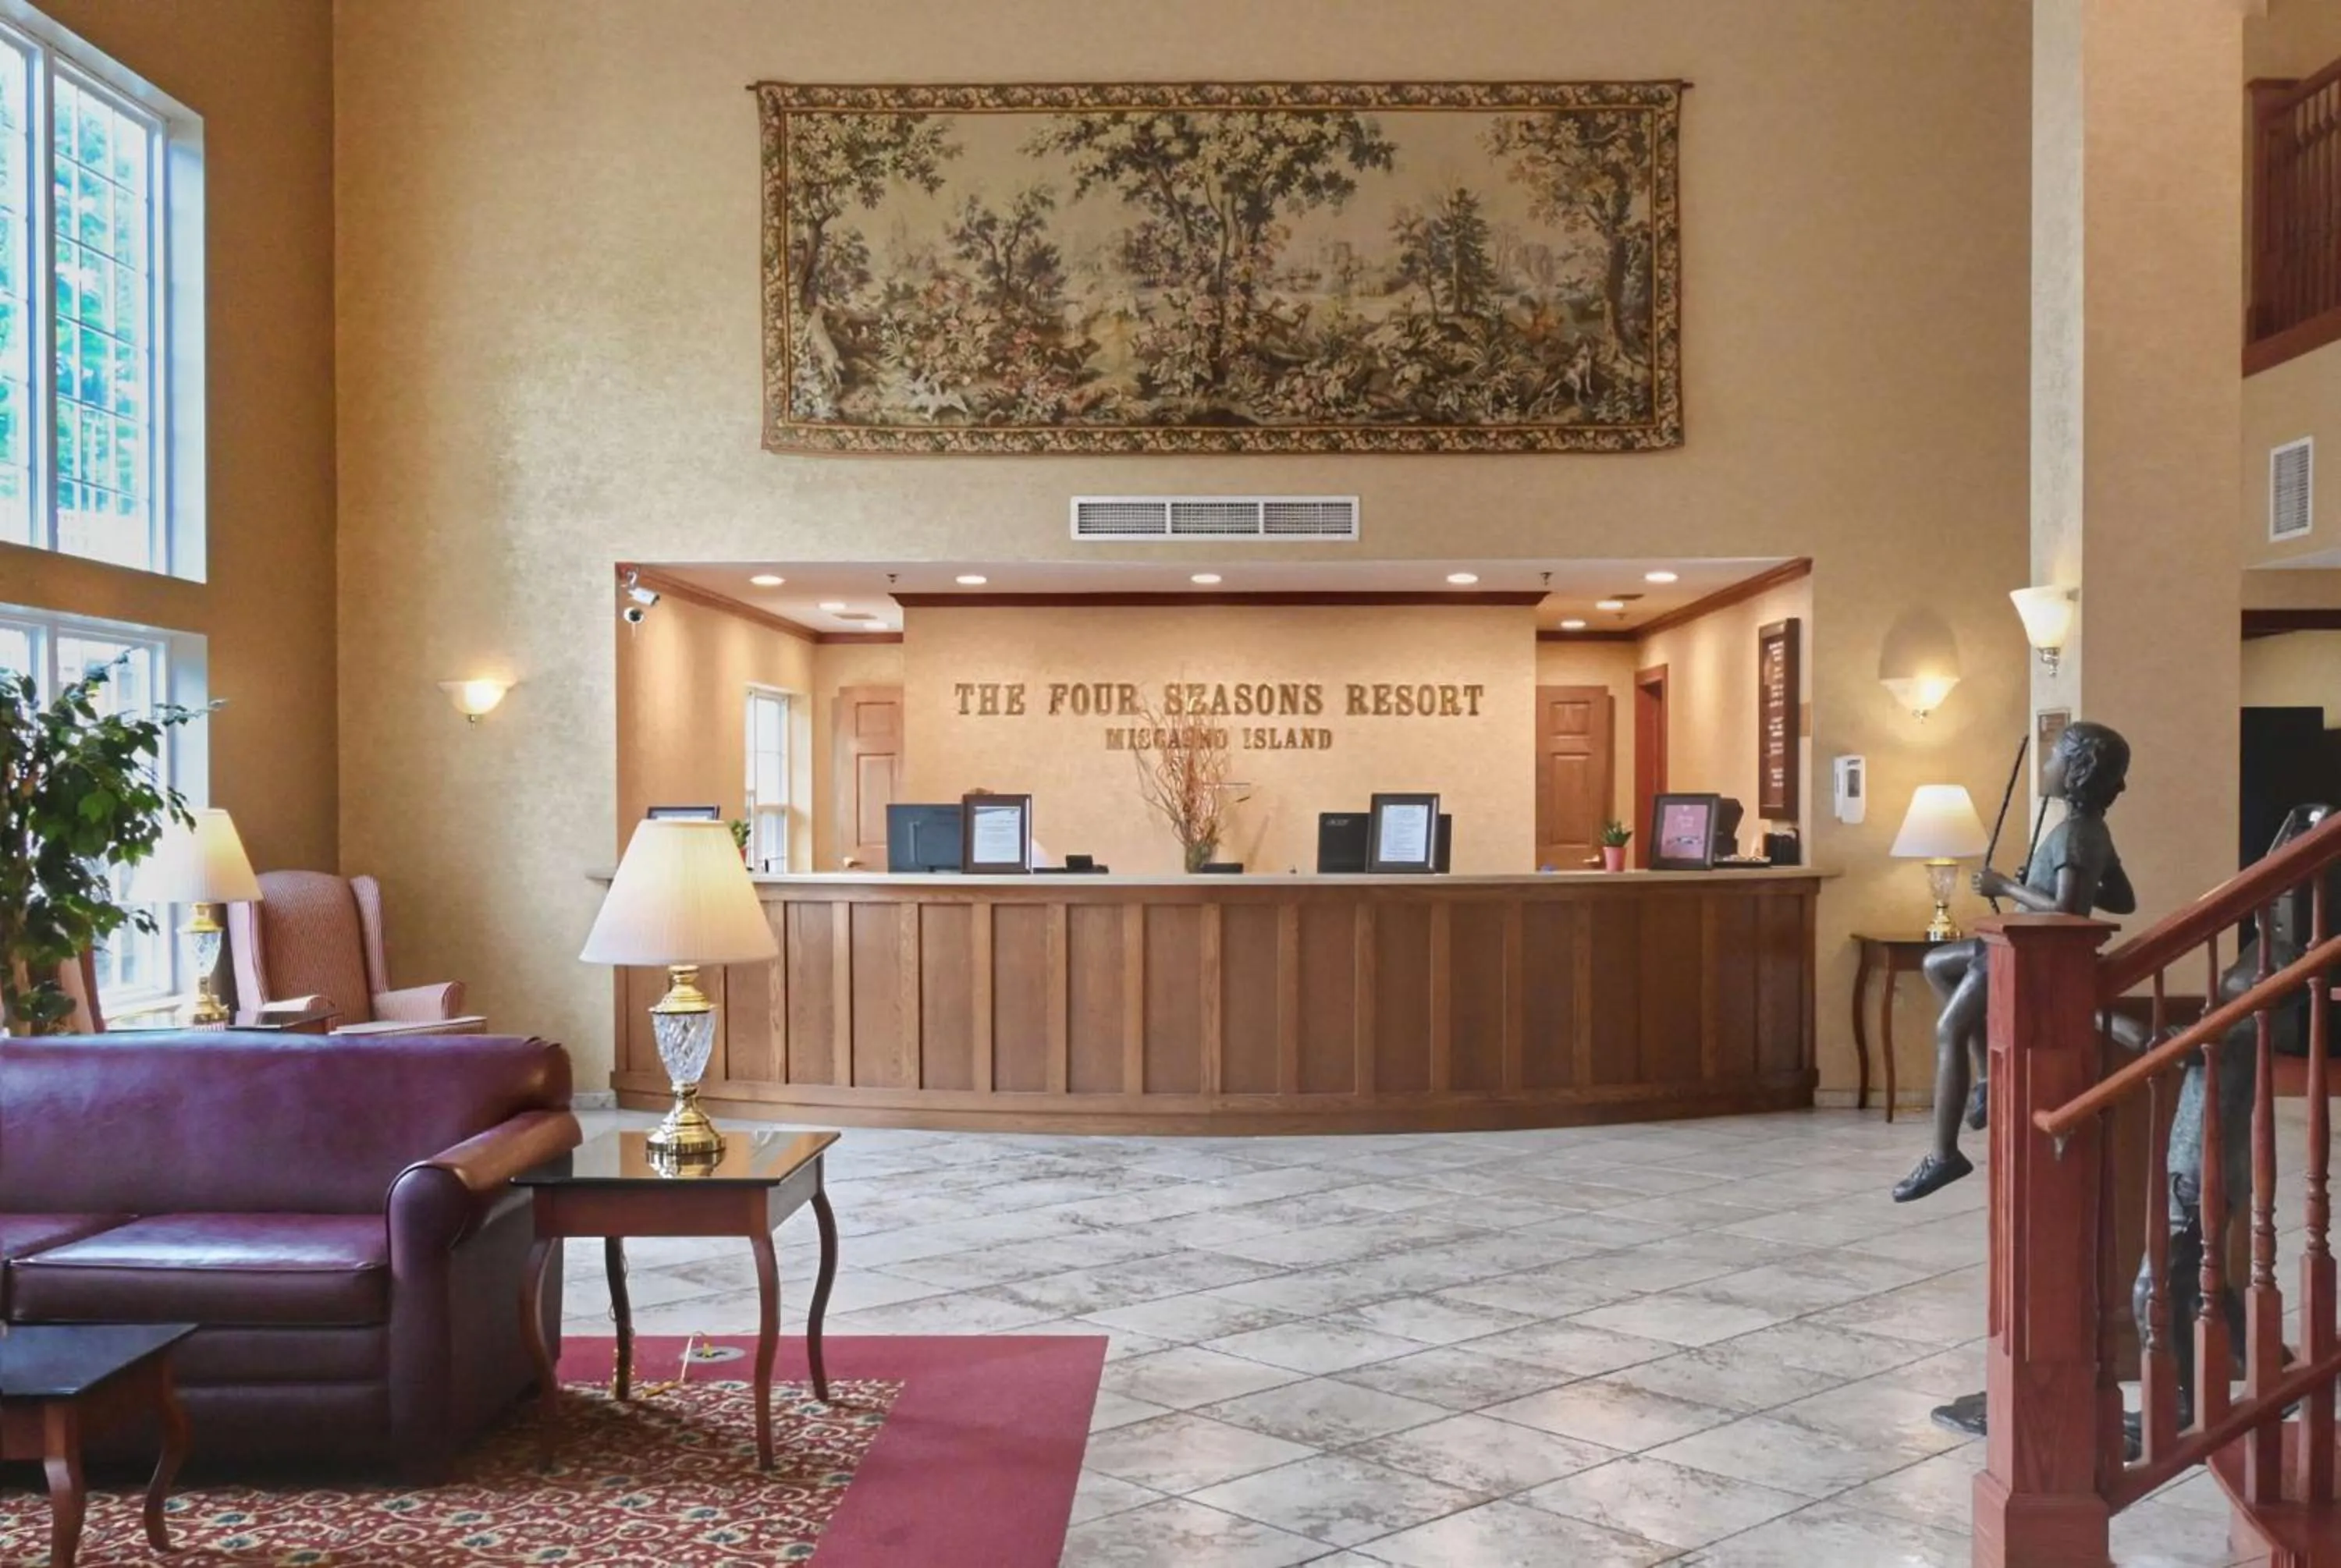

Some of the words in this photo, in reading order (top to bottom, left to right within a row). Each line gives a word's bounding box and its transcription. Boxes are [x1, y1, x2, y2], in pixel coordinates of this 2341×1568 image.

[954, 683, 1025, 716] THE
[1049, 683, 1141, 716] FOUR
[1163, 683, 1324, 716] SEASONS
[1345, 683, 1484, 716] RESORT
[1242, 727, 1333, 750] ISLAND
